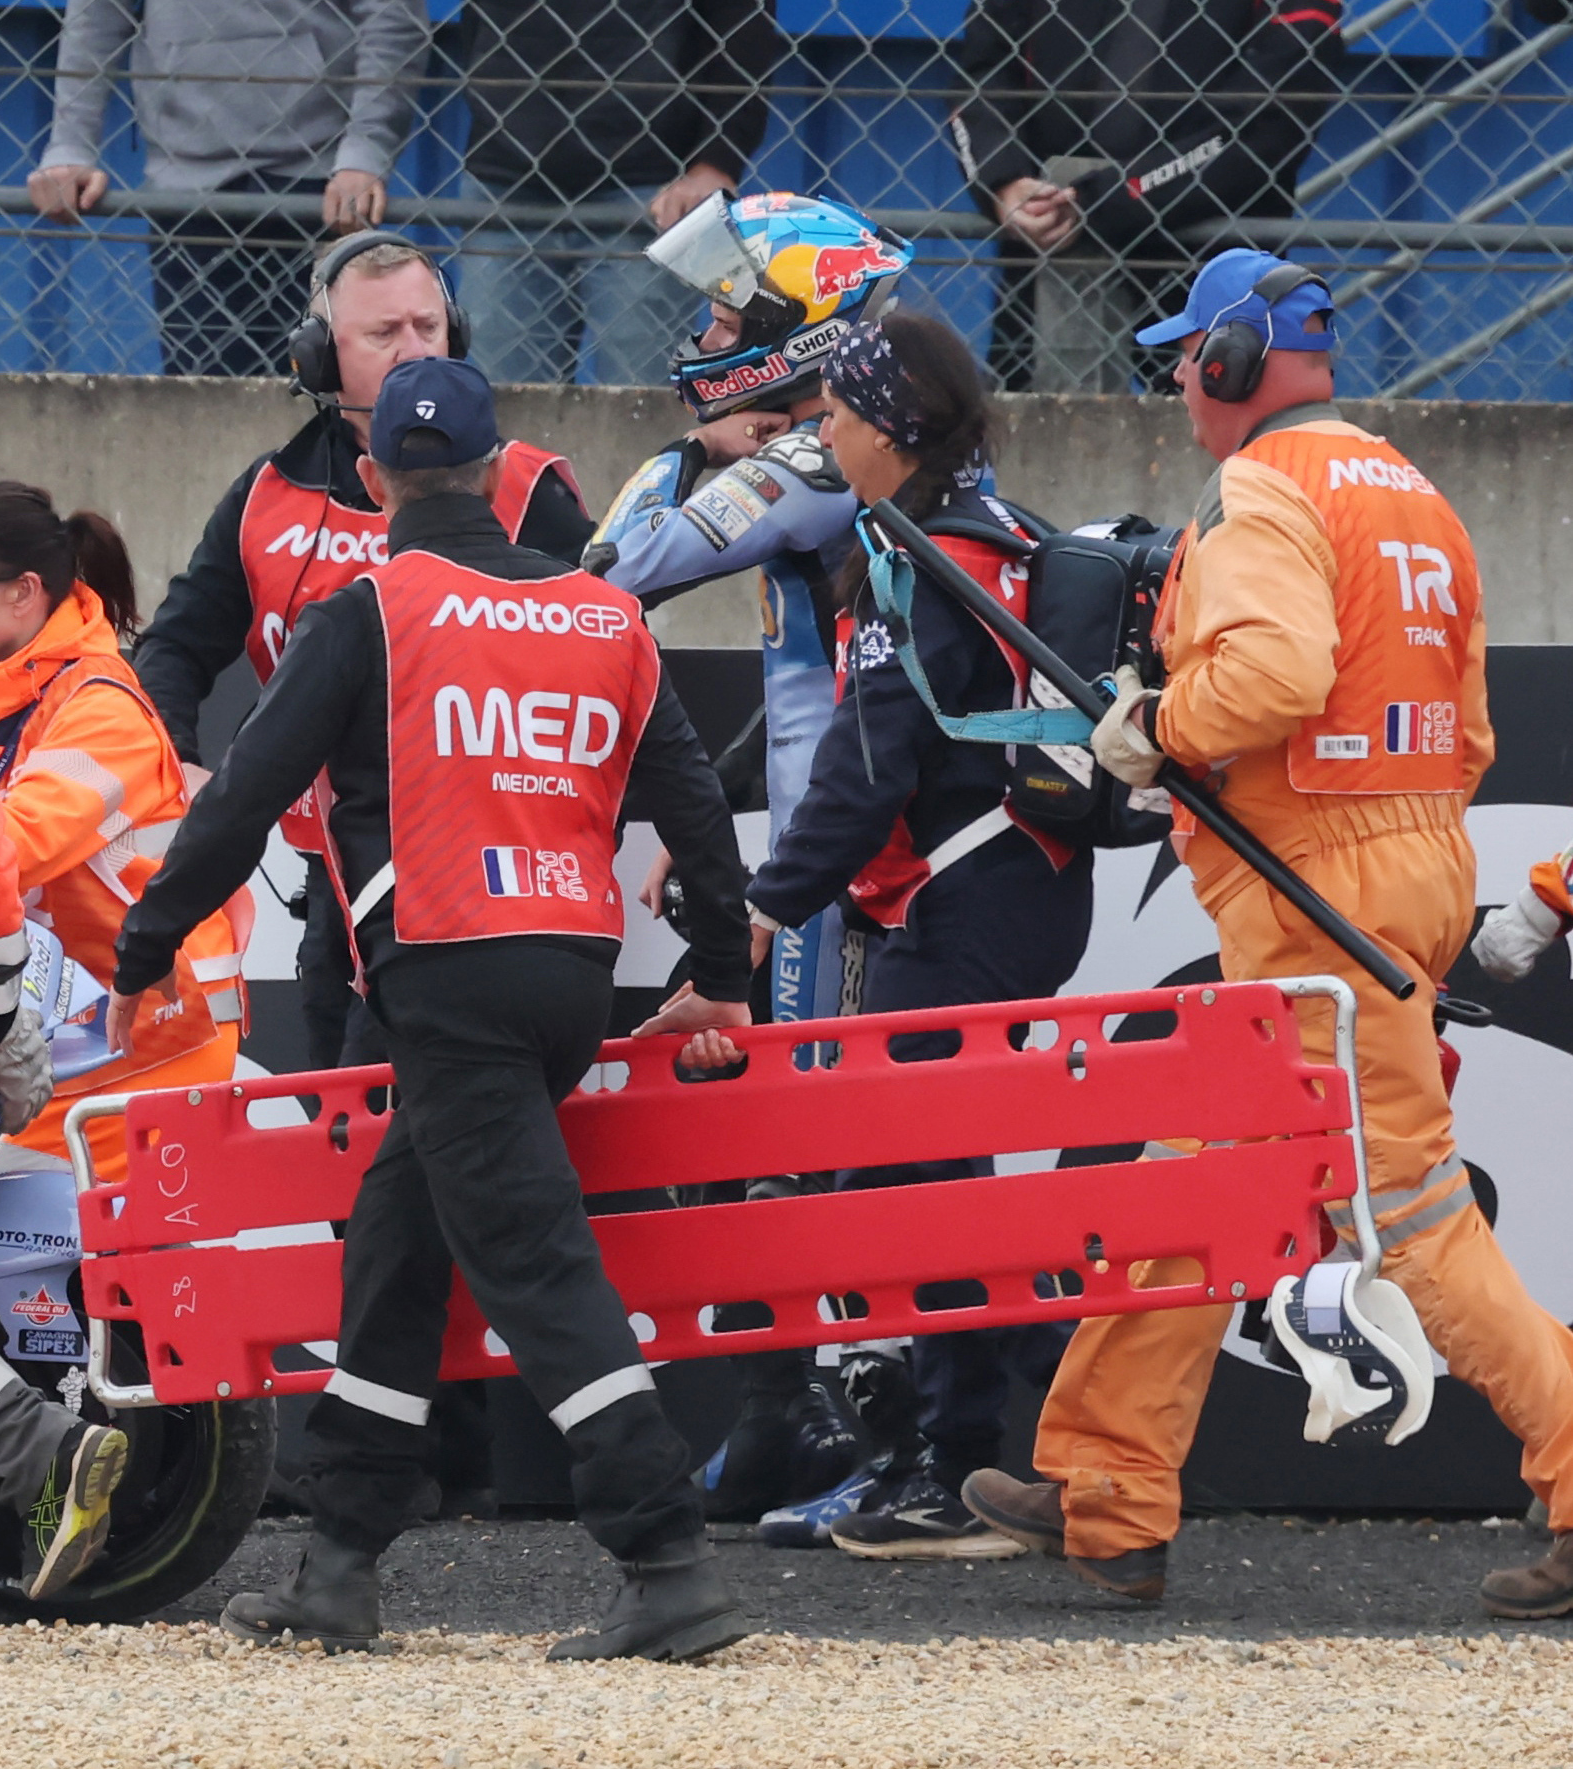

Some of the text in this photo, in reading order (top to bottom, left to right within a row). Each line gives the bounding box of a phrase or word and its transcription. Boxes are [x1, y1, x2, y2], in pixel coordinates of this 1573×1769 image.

[792, 324, 842, 357] SHOEI
[265, 523, 389, 566] Moto
[1378, 540, 1459, 617] TR
[429, 593, 629, 640] MotoGP
[433, 684, 621, 769] MED
[491, 771, 579, 799] MEDICAL
[777, 922, 806, 1009] NEW
[151, 998, 184, 1025] FIM
[157, 1143, 200, 1227] ACO
[14, 1303, 65, 1314] FEDERAL OIL
[25, 1339, 77, 1356] SIPEX
